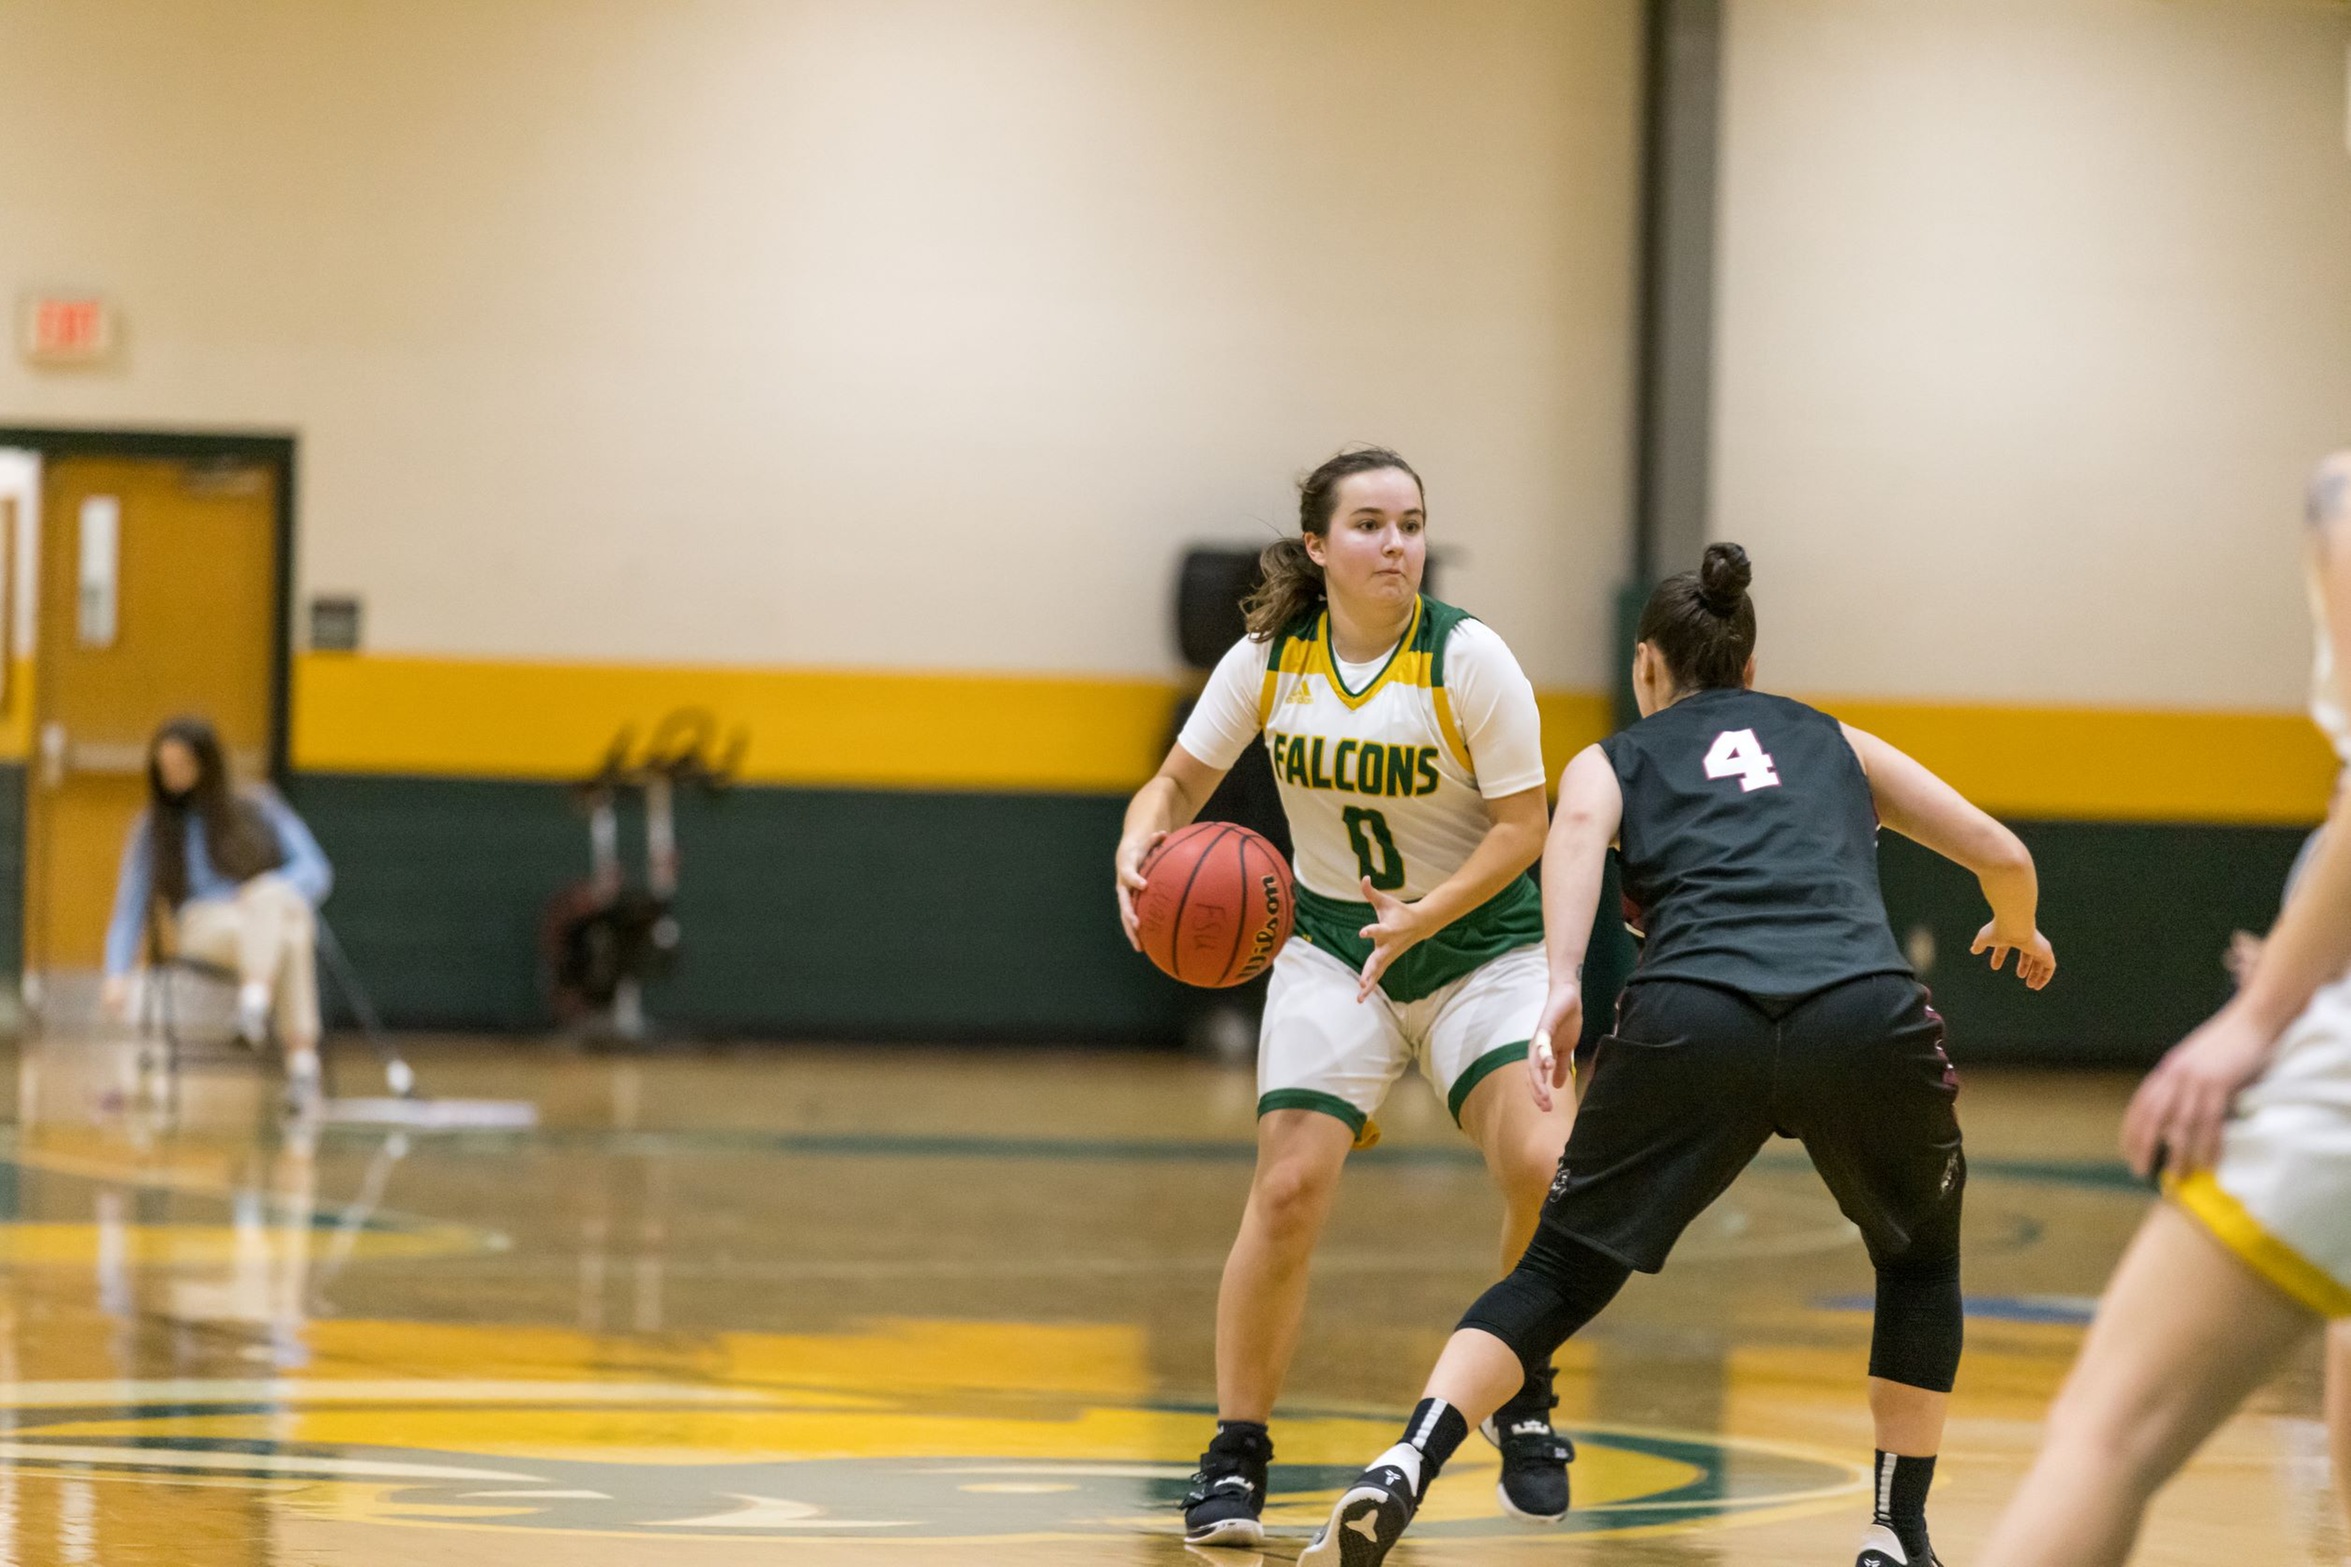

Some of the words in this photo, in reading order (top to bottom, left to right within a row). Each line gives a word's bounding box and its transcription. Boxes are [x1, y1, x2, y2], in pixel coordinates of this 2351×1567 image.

[1274, 732, 1440, 797] FALCONS
[1703, 728, 1782, 792] 4
[1342, 805, 1405, 890] 0
[1235, 875, 1280, 979] Wilson
